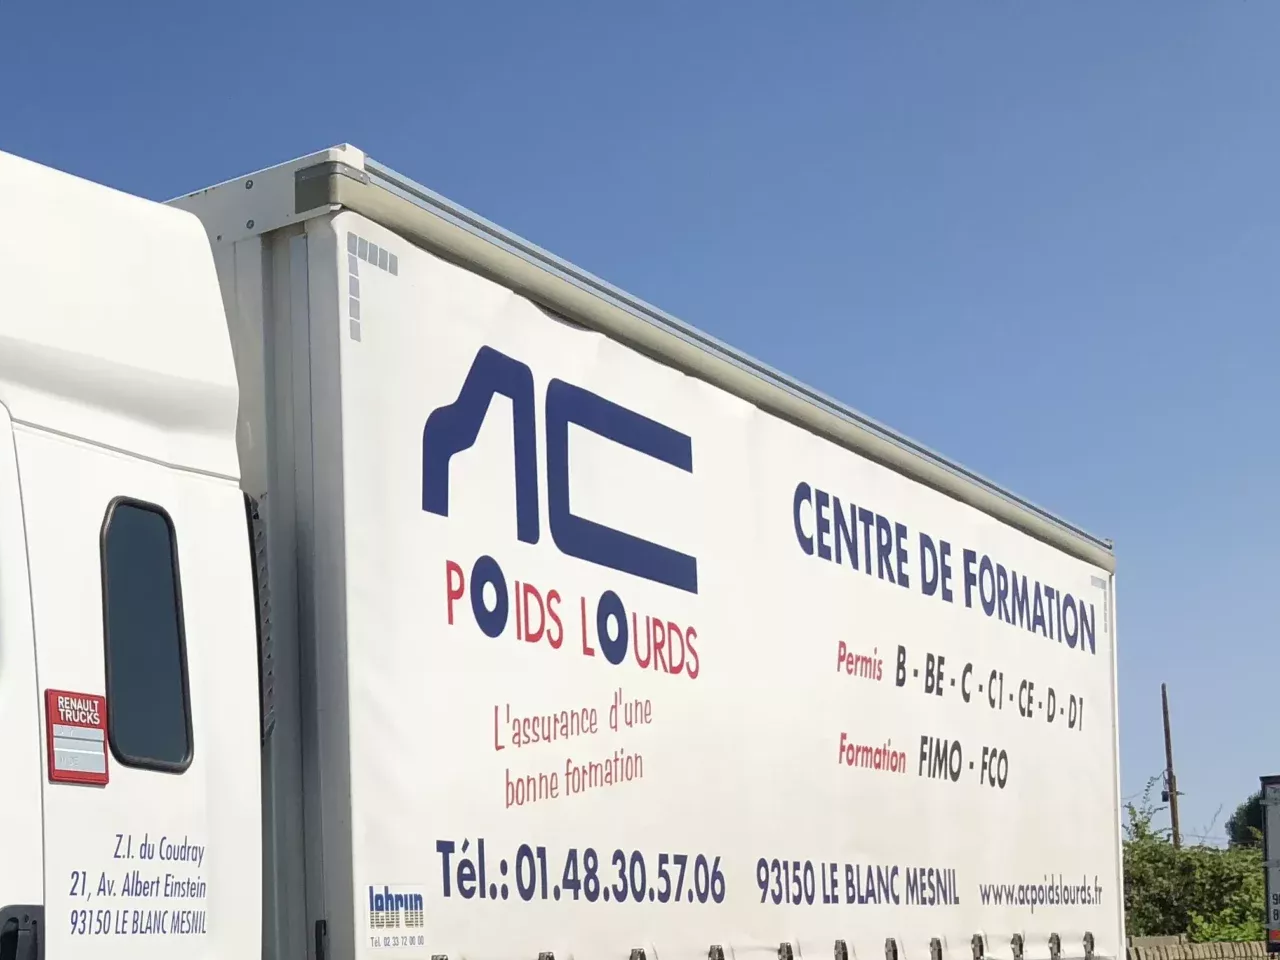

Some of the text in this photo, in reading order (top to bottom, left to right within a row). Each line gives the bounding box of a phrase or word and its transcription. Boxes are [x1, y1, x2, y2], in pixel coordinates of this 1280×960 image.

[421, 345, 698, 595] AC
[793, 481, 1096, 655] CENTRE DE FORMATION
[446, 555, 700, 680] POIDS LOURDS
[57, 696, 99, 713] RENAULT
[837, 640, 883, 681] Permis
[895, 644, 906, 687] B
[924, 652, 945, 696] BE
[961, 662, 973, 703] C
[988, 669, 1003, 710] C1
[1018, 679, 1034, 718] CE
[1047, 687, 1056, 723] D
[1068, 693, 1083, 731] D1
[58, 709, 100, 725] TRUCKS
[494, 687, 652, 751] L'assurance d'une
[506, 747, 643, 809] bonne formation
[838, 732, 906, 774] Formation
[919, 735, 962, 782] FIMO
[980, 746, 1009, 789] FCO
[114, 833, 205, 868] Z.I. du Coudray
[69, 870, 206, 901] 21, Av. Albert Einstein
[756, 857, 960, 906] 93150 LE BLANC MESNIL
[979, 873, 1103, 914] www.acpoidslourds.fr
[70, 909, 206, 935] 93150 LE BLANC MESNIL
